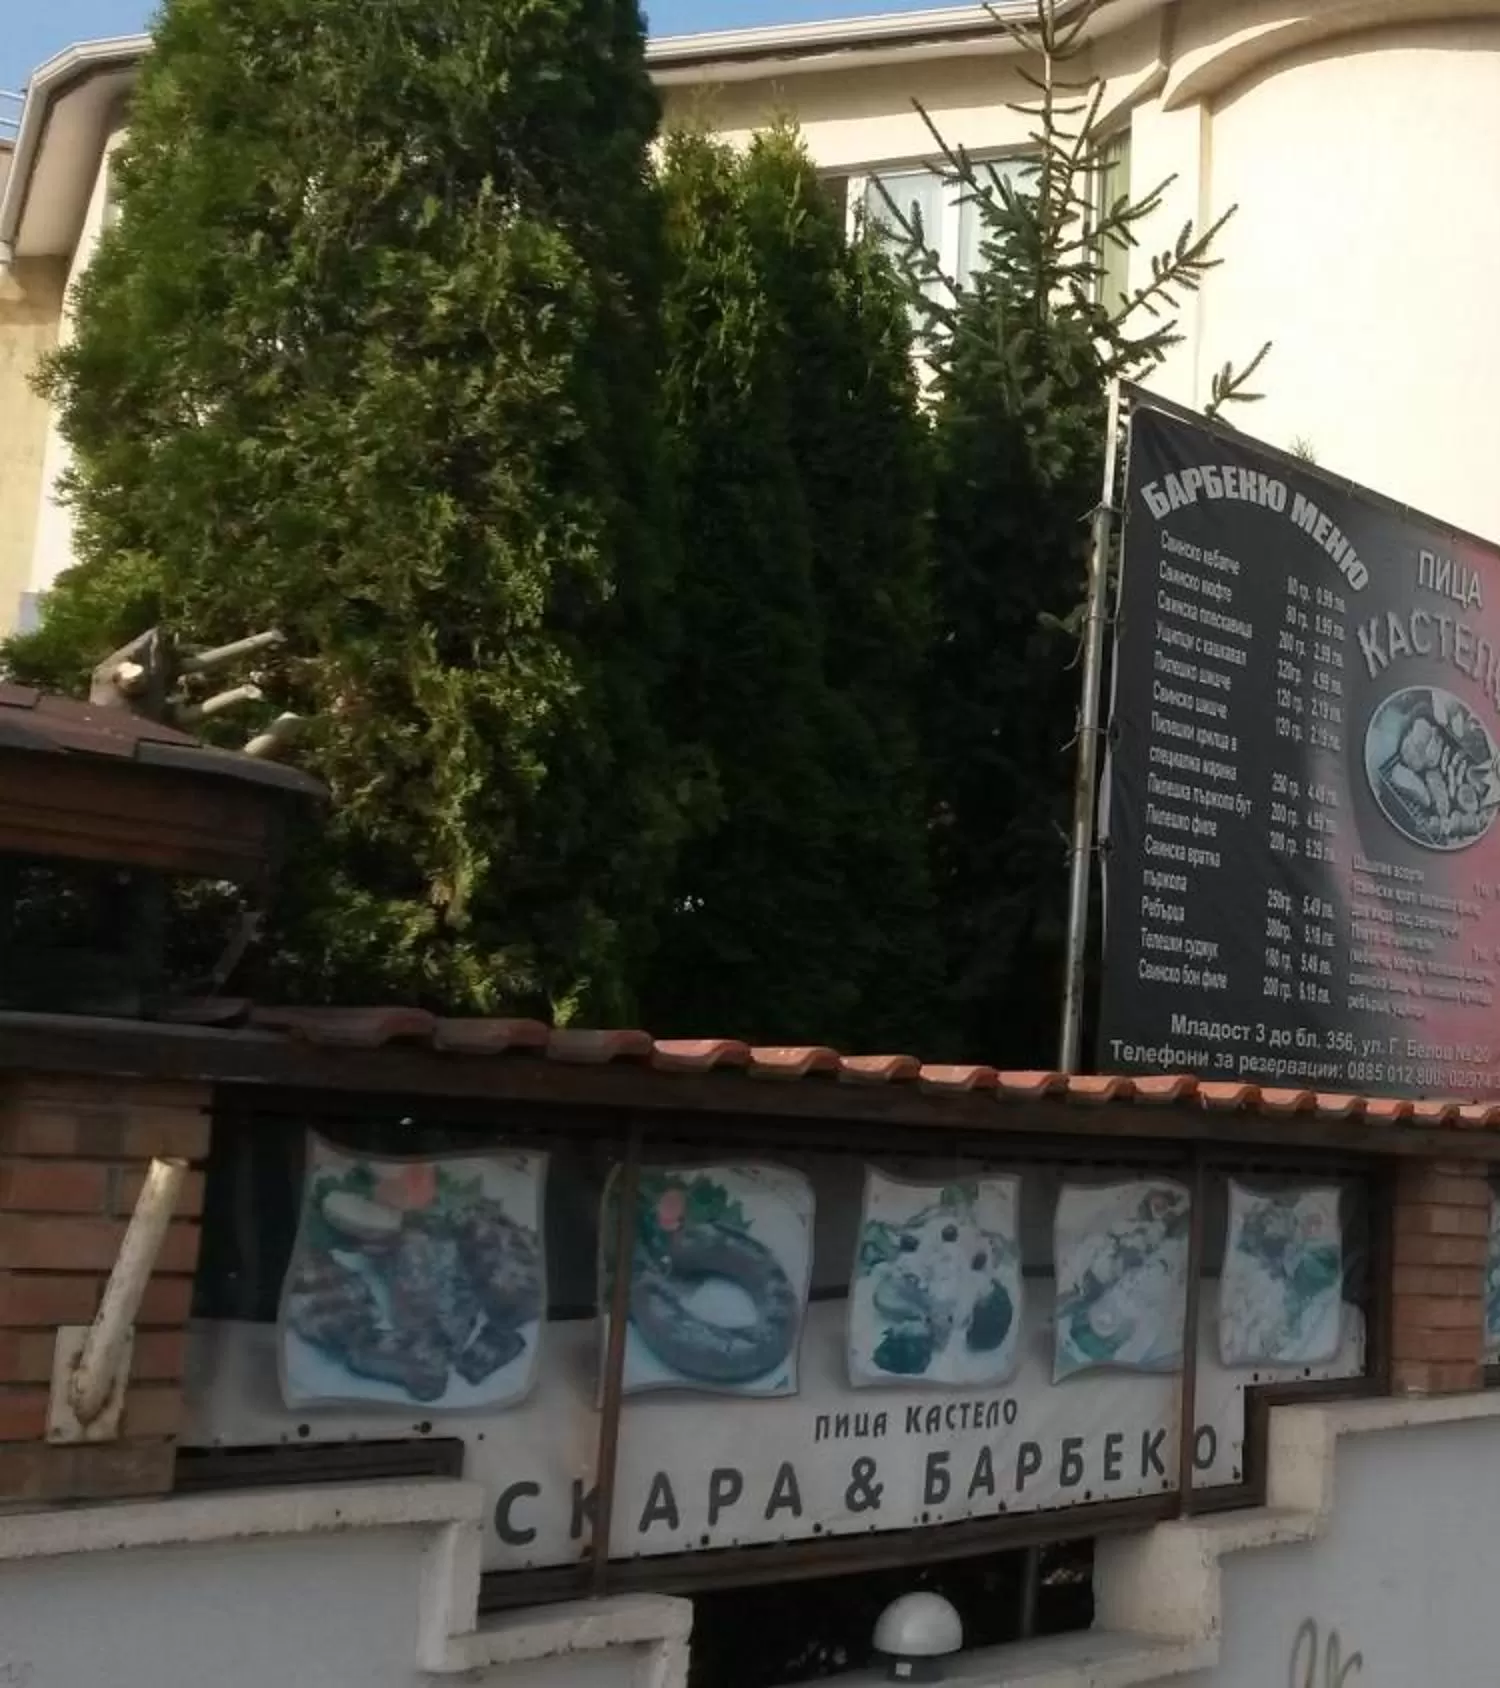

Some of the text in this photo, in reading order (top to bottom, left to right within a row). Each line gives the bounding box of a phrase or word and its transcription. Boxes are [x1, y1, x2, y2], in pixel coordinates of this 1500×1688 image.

[1140, 463, 1370, 592] БАРБЕКЮ МЕНЮ
[1418, 548, 1484, 610] ПИЦА
[1169, 1011, 1251, 1044] Младост
[1254, 1022, 1266, 1041] 3
[1268, 1027, 1292, 1049] до
[1295, 1026, 1320, 1049] бл.
[1108, 1037, 1210, 1072] Телефони
[1214, 1050, 1233, 1069] за
[1238, 1053, 1344, 1083] резервации:
[815, 1398, 1018, 1443] ПИЦА КАСТЕЛО
[494, 1461, 803, 1546] СКАРА
[844, 1456, 885, 1512] &
